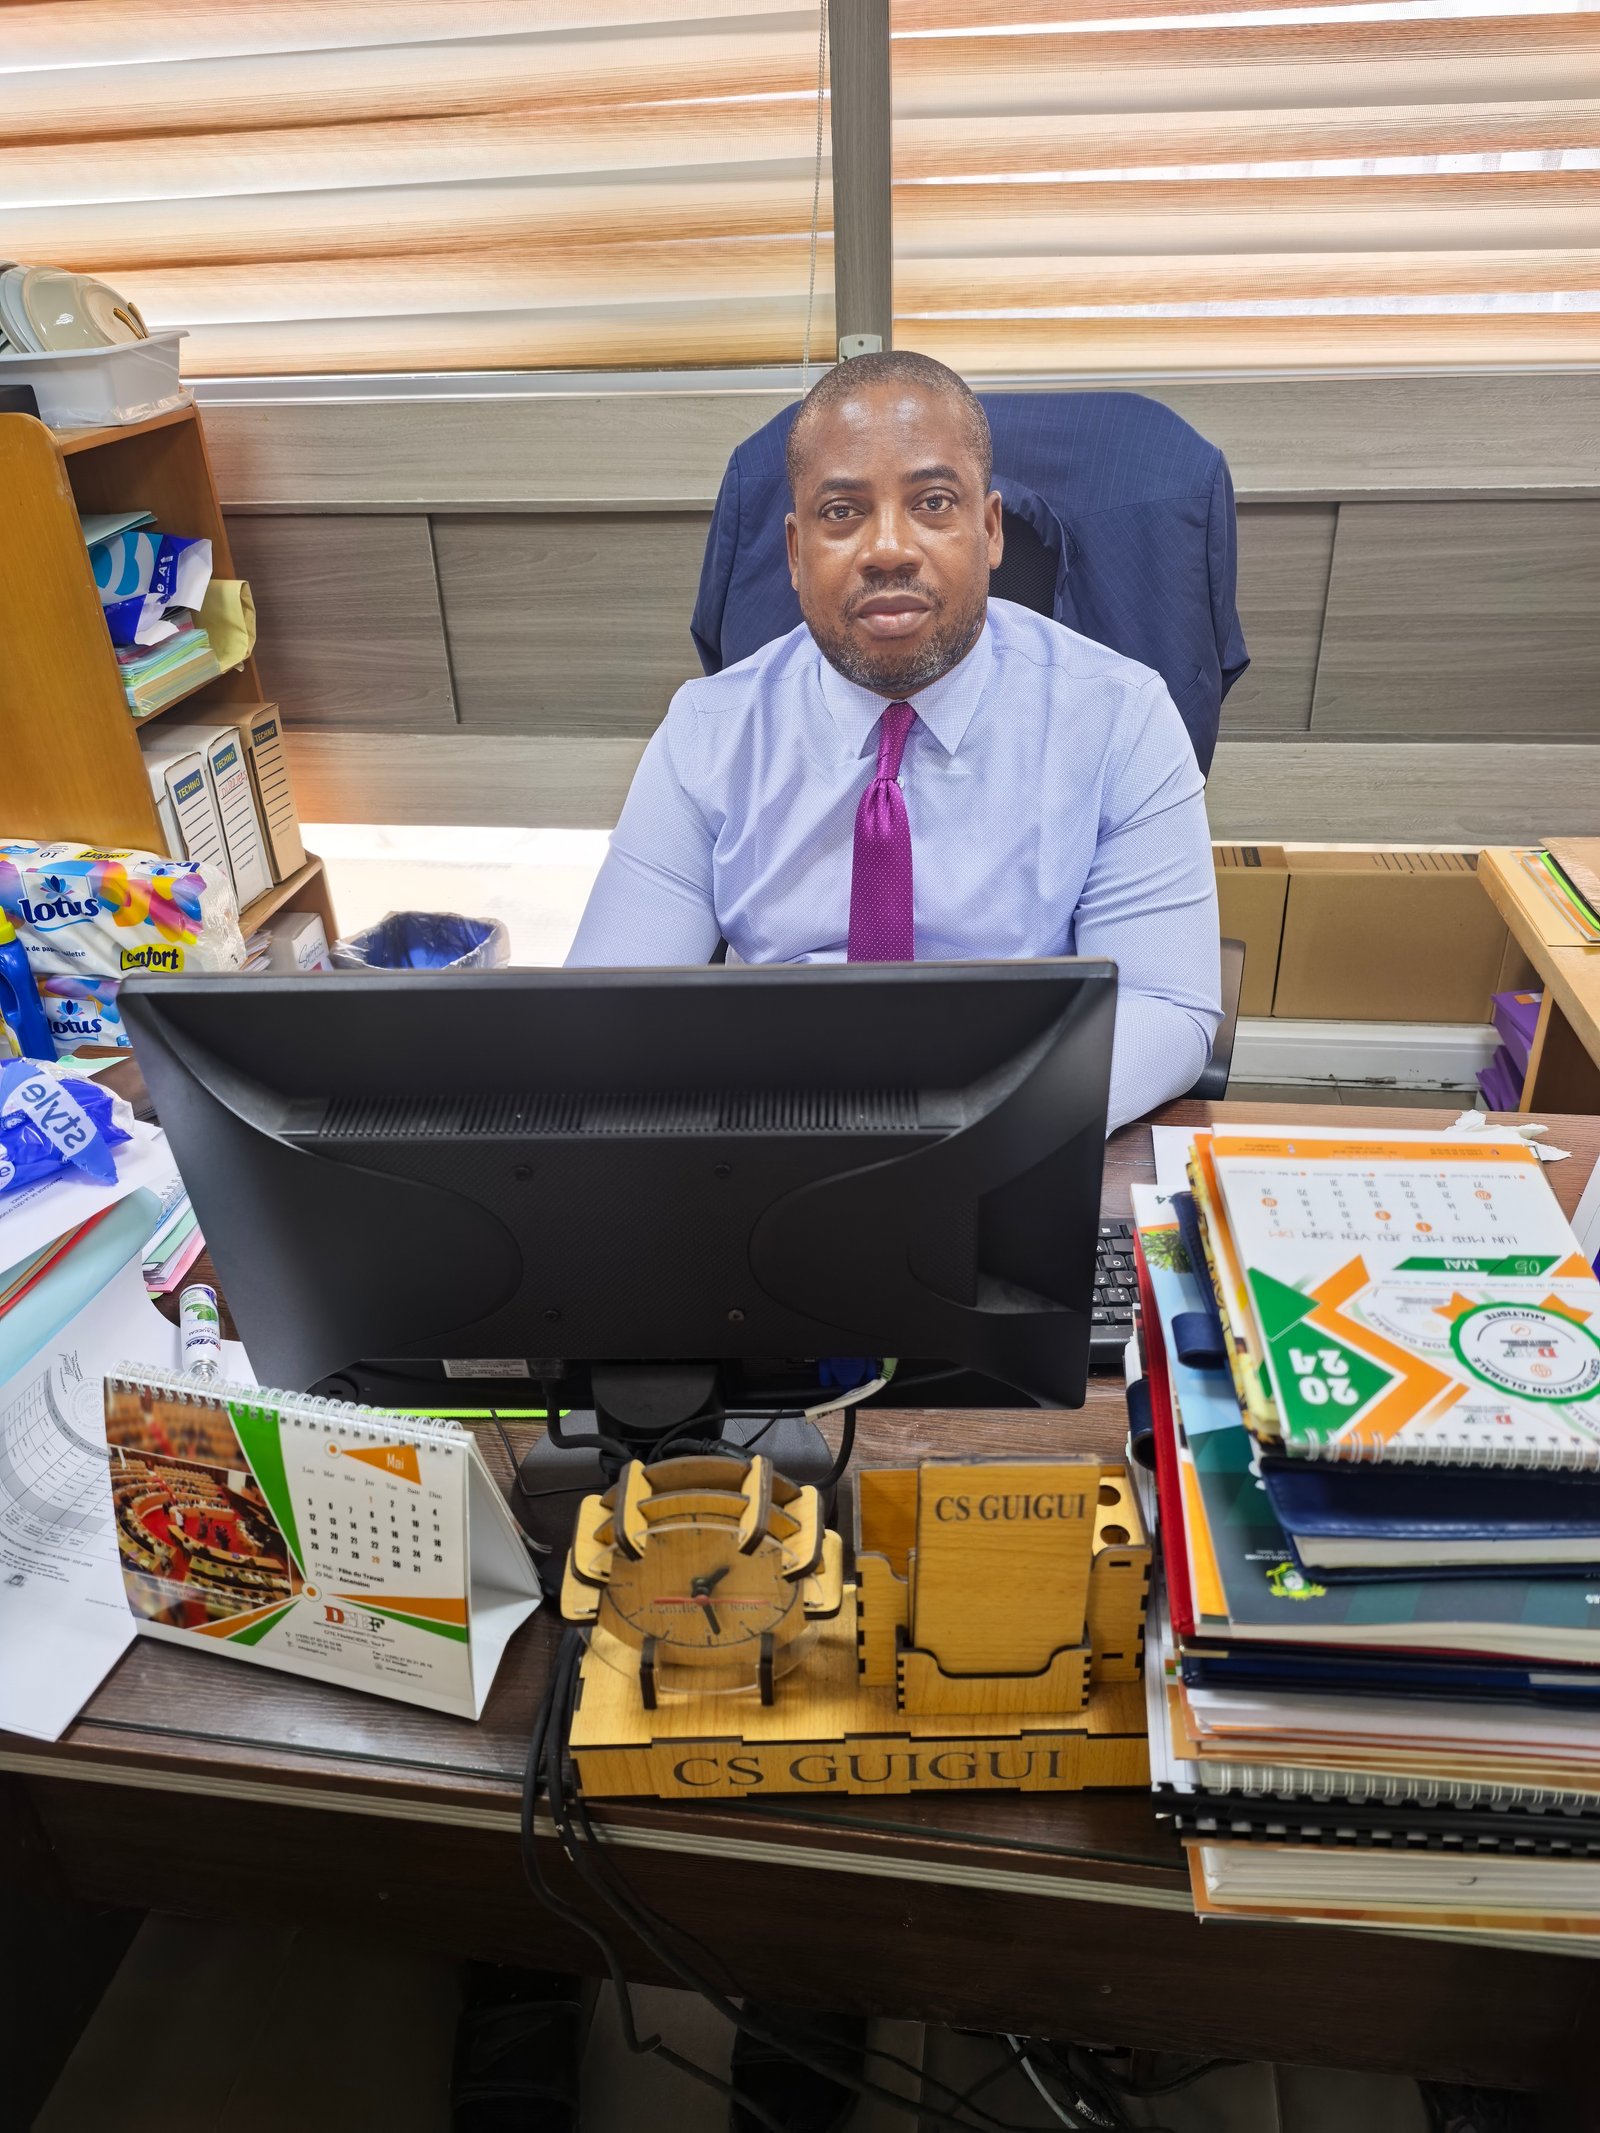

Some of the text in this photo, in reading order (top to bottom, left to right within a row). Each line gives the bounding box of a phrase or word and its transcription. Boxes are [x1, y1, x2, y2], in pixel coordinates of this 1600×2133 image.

[254, 726, 275, 742] TECHNO
[215, 750, 235, 771] TECHNO
[177, 777, 201, 800] TECHNO
[19, 897, 100, 924] lotus
[1443, 1258, 1540, 1275] 05 MAI
[1485, 1309, 1547, 1322] MULTISITE
[1288, 1348, 1349, 1376] 24
[1299, 1376, 1360, 1406] 20
[386, 1453, 405, 1470] Mai
[934, 1492, 1086, 1521] CS GUIGUI
[672, 1750, 1064, 1787] CS GUIGUI
